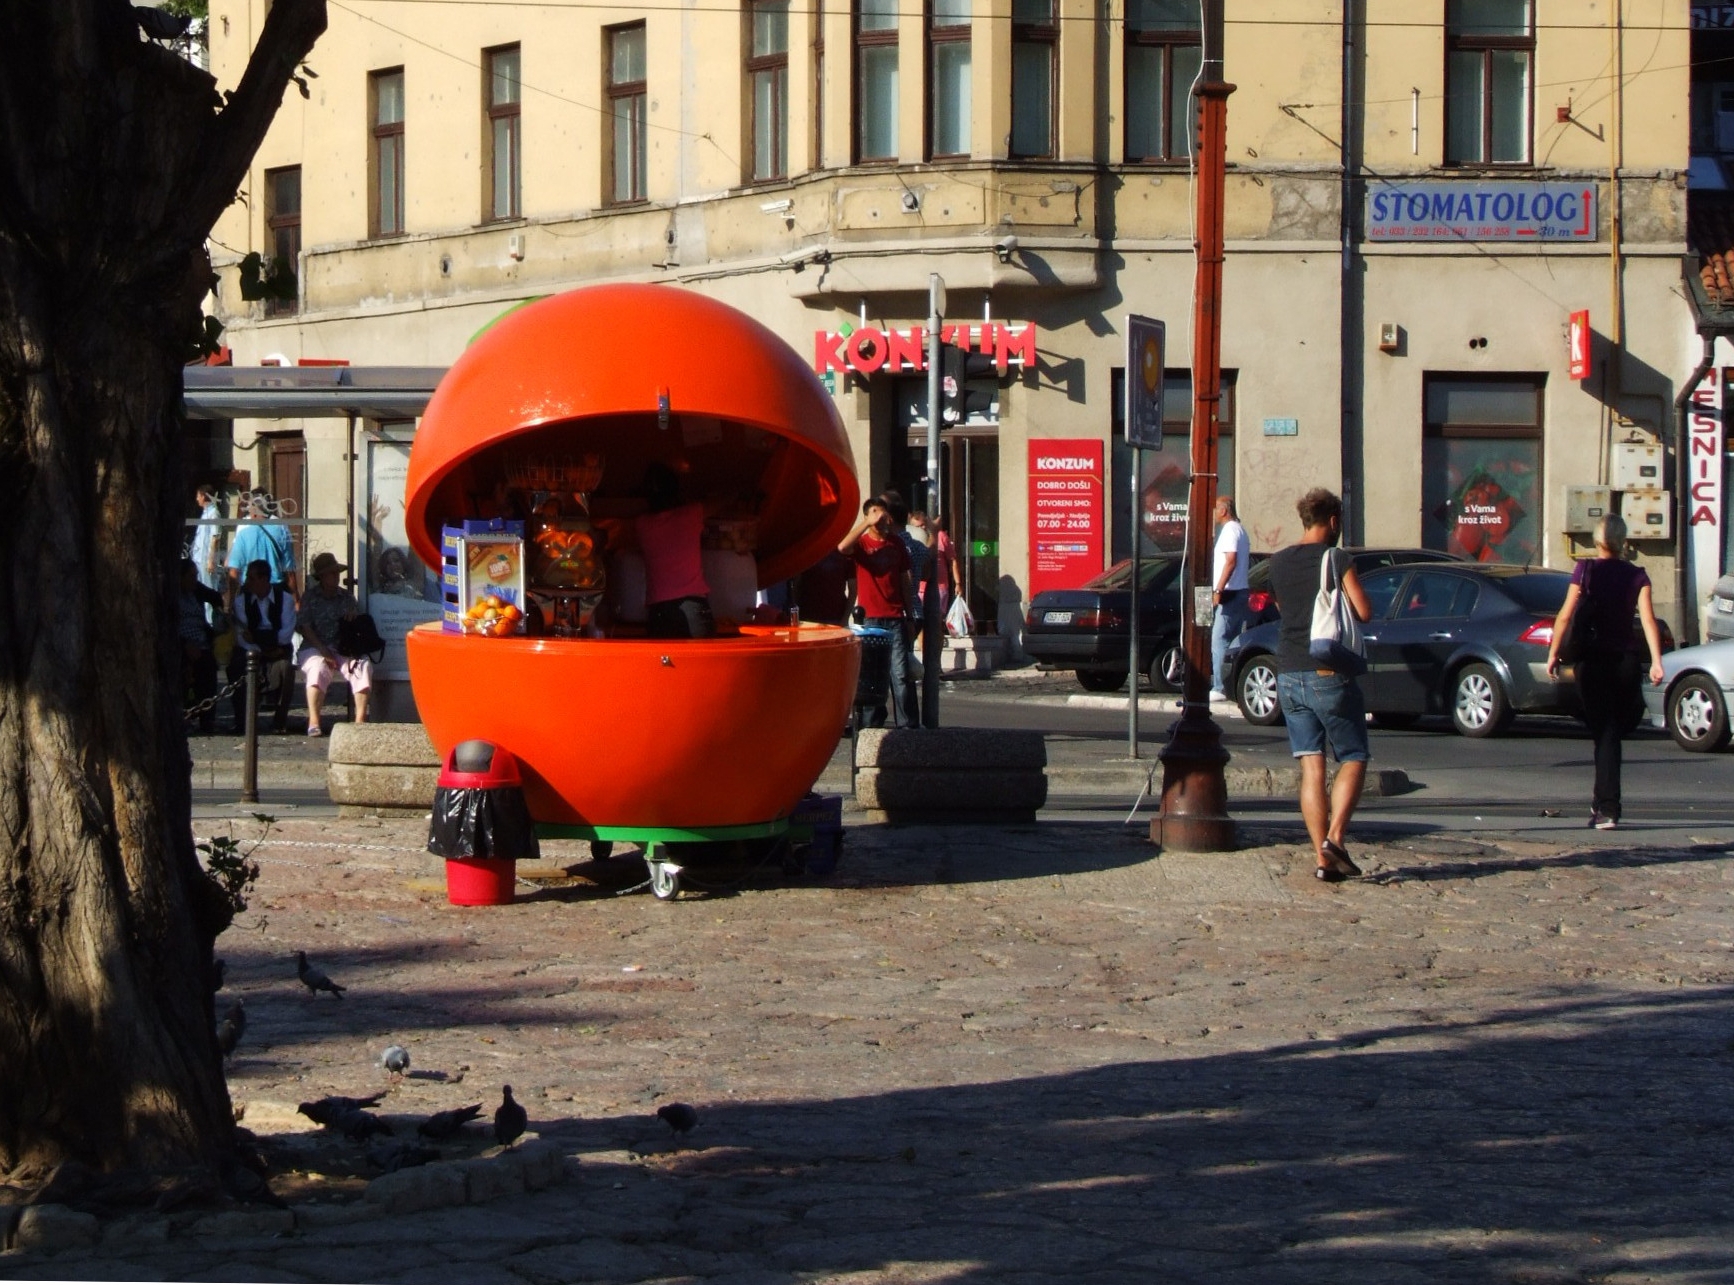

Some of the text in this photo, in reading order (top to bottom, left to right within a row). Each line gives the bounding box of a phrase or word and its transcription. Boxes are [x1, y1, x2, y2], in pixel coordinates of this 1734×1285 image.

[1372, 192, 1577, 222] STOMATOLOG
[1539, 226, 1570, 238] 30 m
[1571, 323, 1583, 362] K
[1037, 457, 1094, 470] KONZUM
[1037, 480, 1091, 490] DOBRO DOŠLI
[1037, 499, 1092, 508] OTVORENI SMO:
[1162, 502, 1188, 511] Vama
[1464, 503, 1496, 514] s Vama
[1150, 513, 1170, 522] kroz
[1457, 513, 1502, 524] kroz život
[1037, 520, 1061, 529] 07.00
[1067, 520, 1090, 529] 24.00
